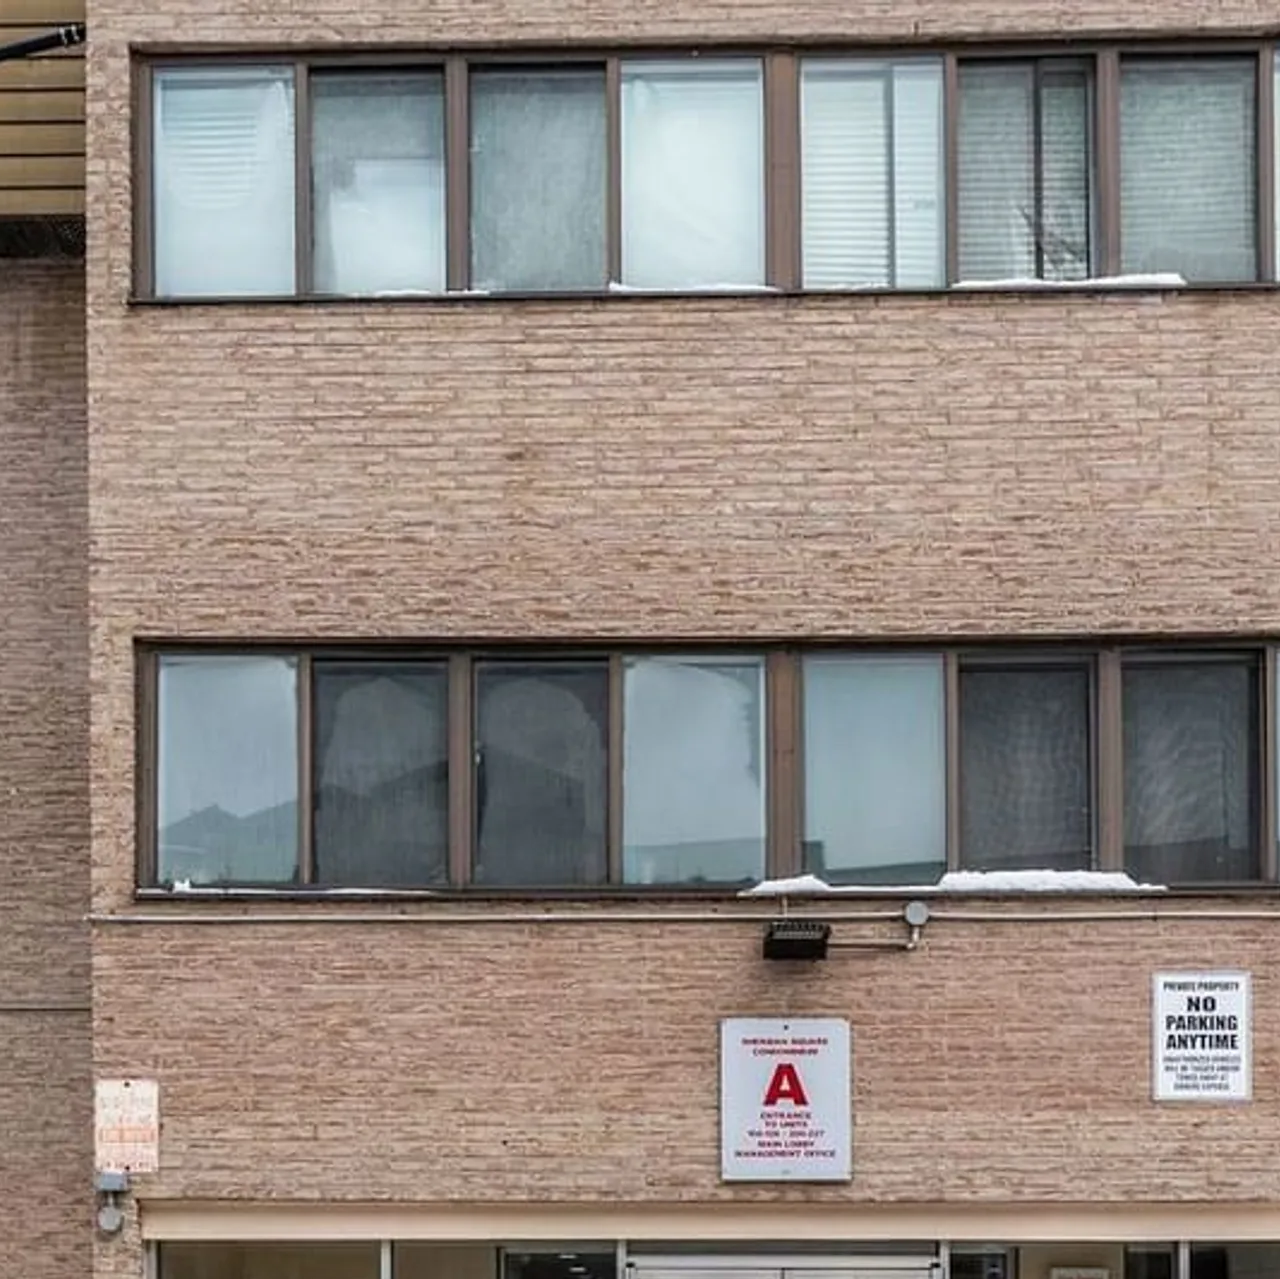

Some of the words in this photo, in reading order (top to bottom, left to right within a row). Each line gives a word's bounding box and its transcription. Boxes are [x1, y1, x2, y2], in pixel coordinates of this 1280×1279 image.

[1163, 981, 1195, 991] PRIVATE
[1197, 981, 1240, 991] PROPERTY
[1186, 996, 1217, 1012] NO
[1165, 1015, 1238, 1031] PARKING
[1166, 1034, 1239, 1050] ANYTIME
[763, 1063, 808, 1106] A
[760, 1111, 811, 1119] ENTRANCE
[758, 1140, 782, 1148] MAIN
[784, 1140, 814, 1148] LOBBY
[735, 1150, 801, 1158] MANAGEMENT
[803, 1150, 836, 1158] OFFICE
